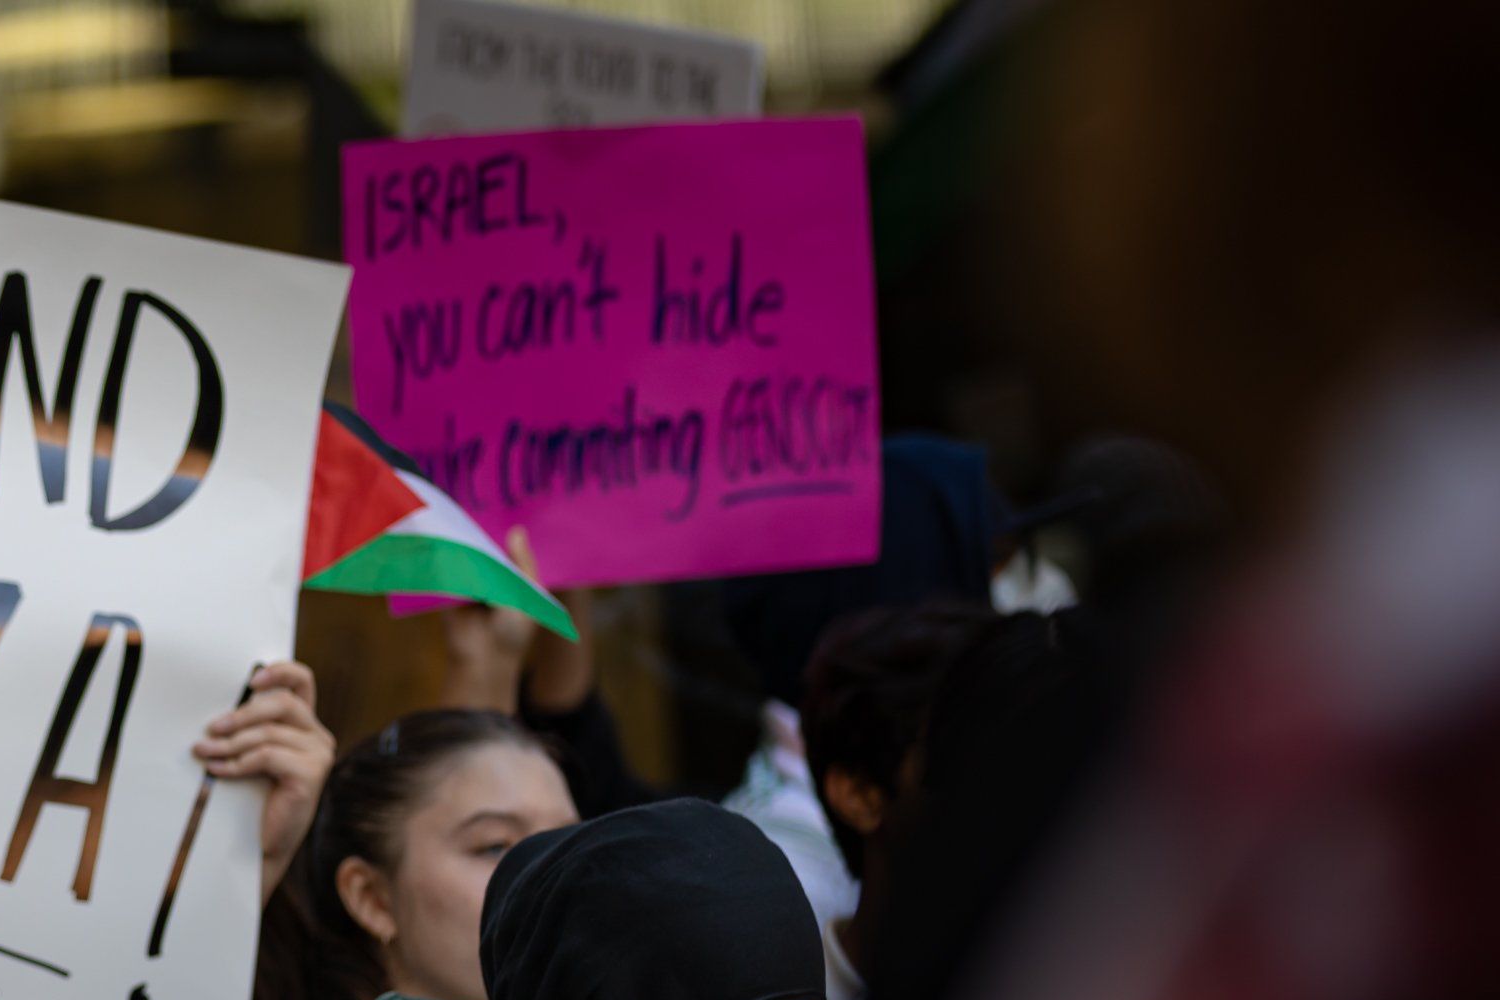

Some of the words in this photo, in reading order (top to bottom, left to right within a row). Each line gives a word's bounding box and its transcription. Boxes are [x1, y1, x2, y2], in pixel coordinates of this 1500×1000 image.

[363, 152, 567, 262] ISRAEL,
[383, 298, 463, 413] you
[650, 232, 786, 348] hide
